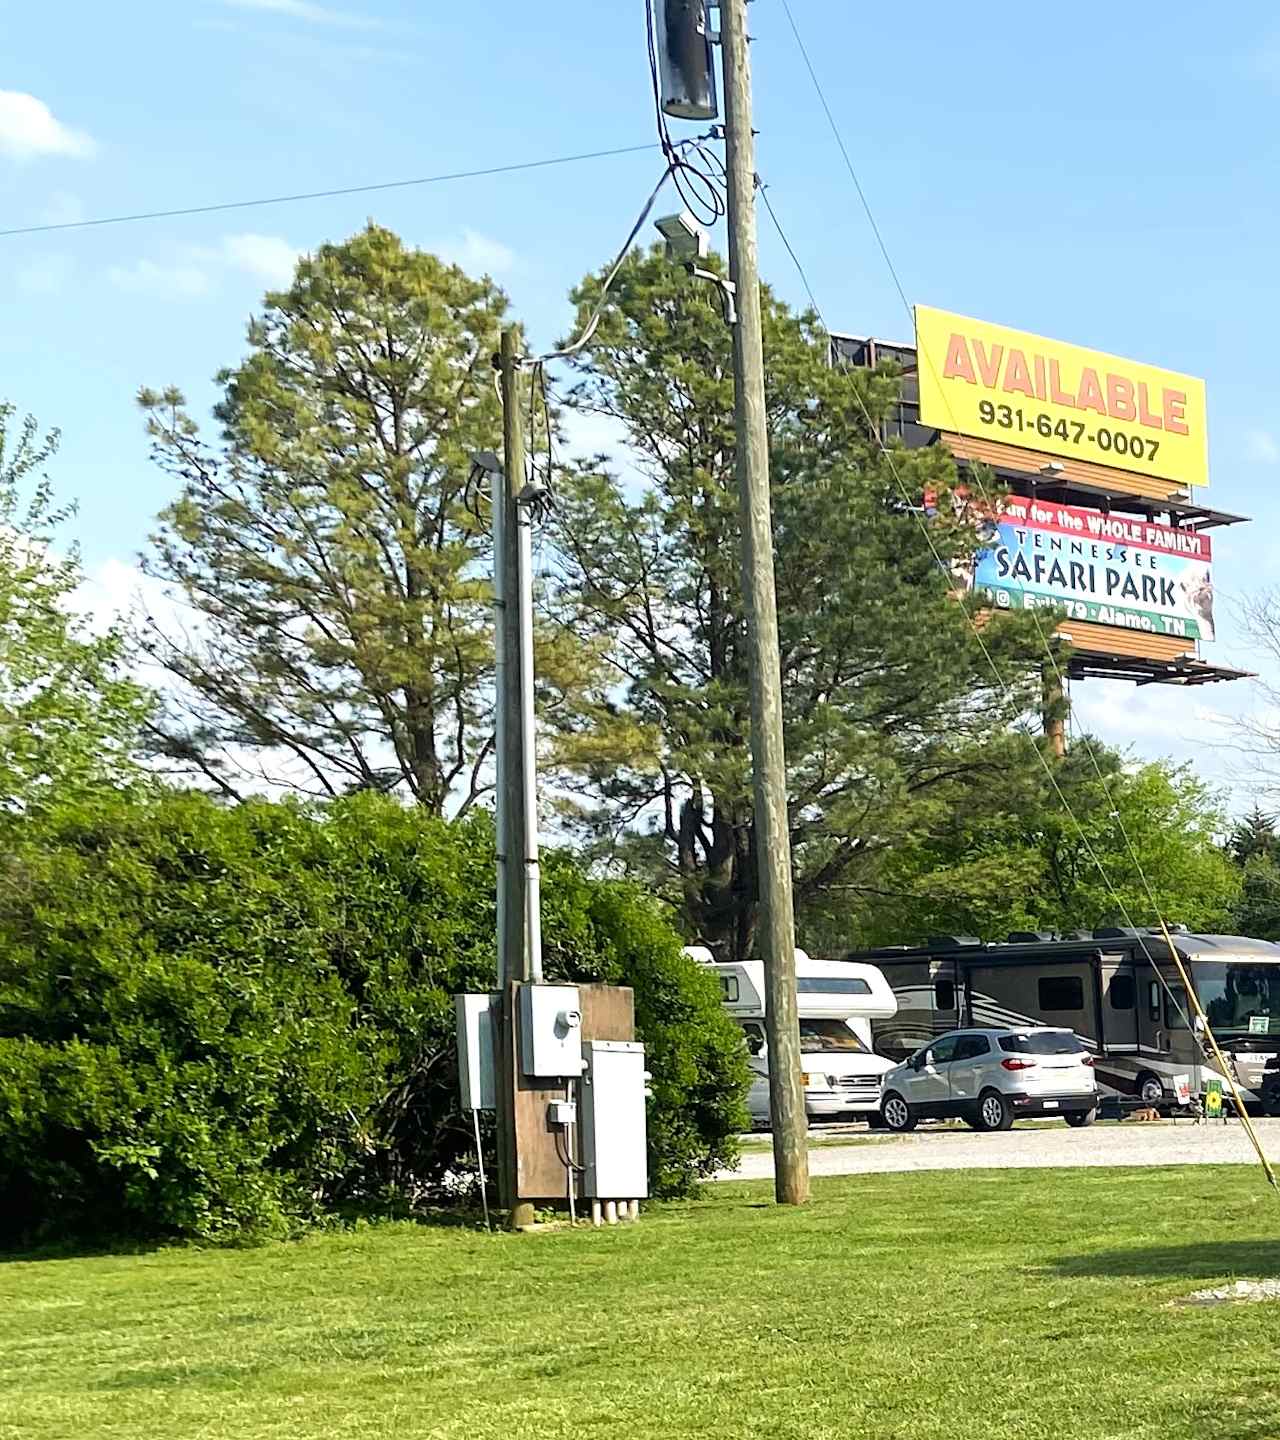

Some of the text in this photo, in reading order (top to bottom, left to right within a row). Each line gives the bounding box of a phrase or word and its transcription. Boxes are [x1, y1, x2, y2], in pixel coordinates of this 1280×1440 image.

[943, 333, 1189, 436] AVAILABLE
[978, 399, 1160, 462] 931-647-0007
[1015, 530, 1157, 569] TENNESSEE
[1030, 504, 1053, 522] for
[1057, 510, 1083, 529] the
[1087, 515, 1142, 543] WHOLE
[1146, 530, 1201, 555] FAMILY!
[997, 548, 1176, 608] SAFARI PARK
[1065, 600, 1088, 619] 79
[1099, 605, 1156, 633] Alamo,
[1160, 616, 1186, 636] TN
